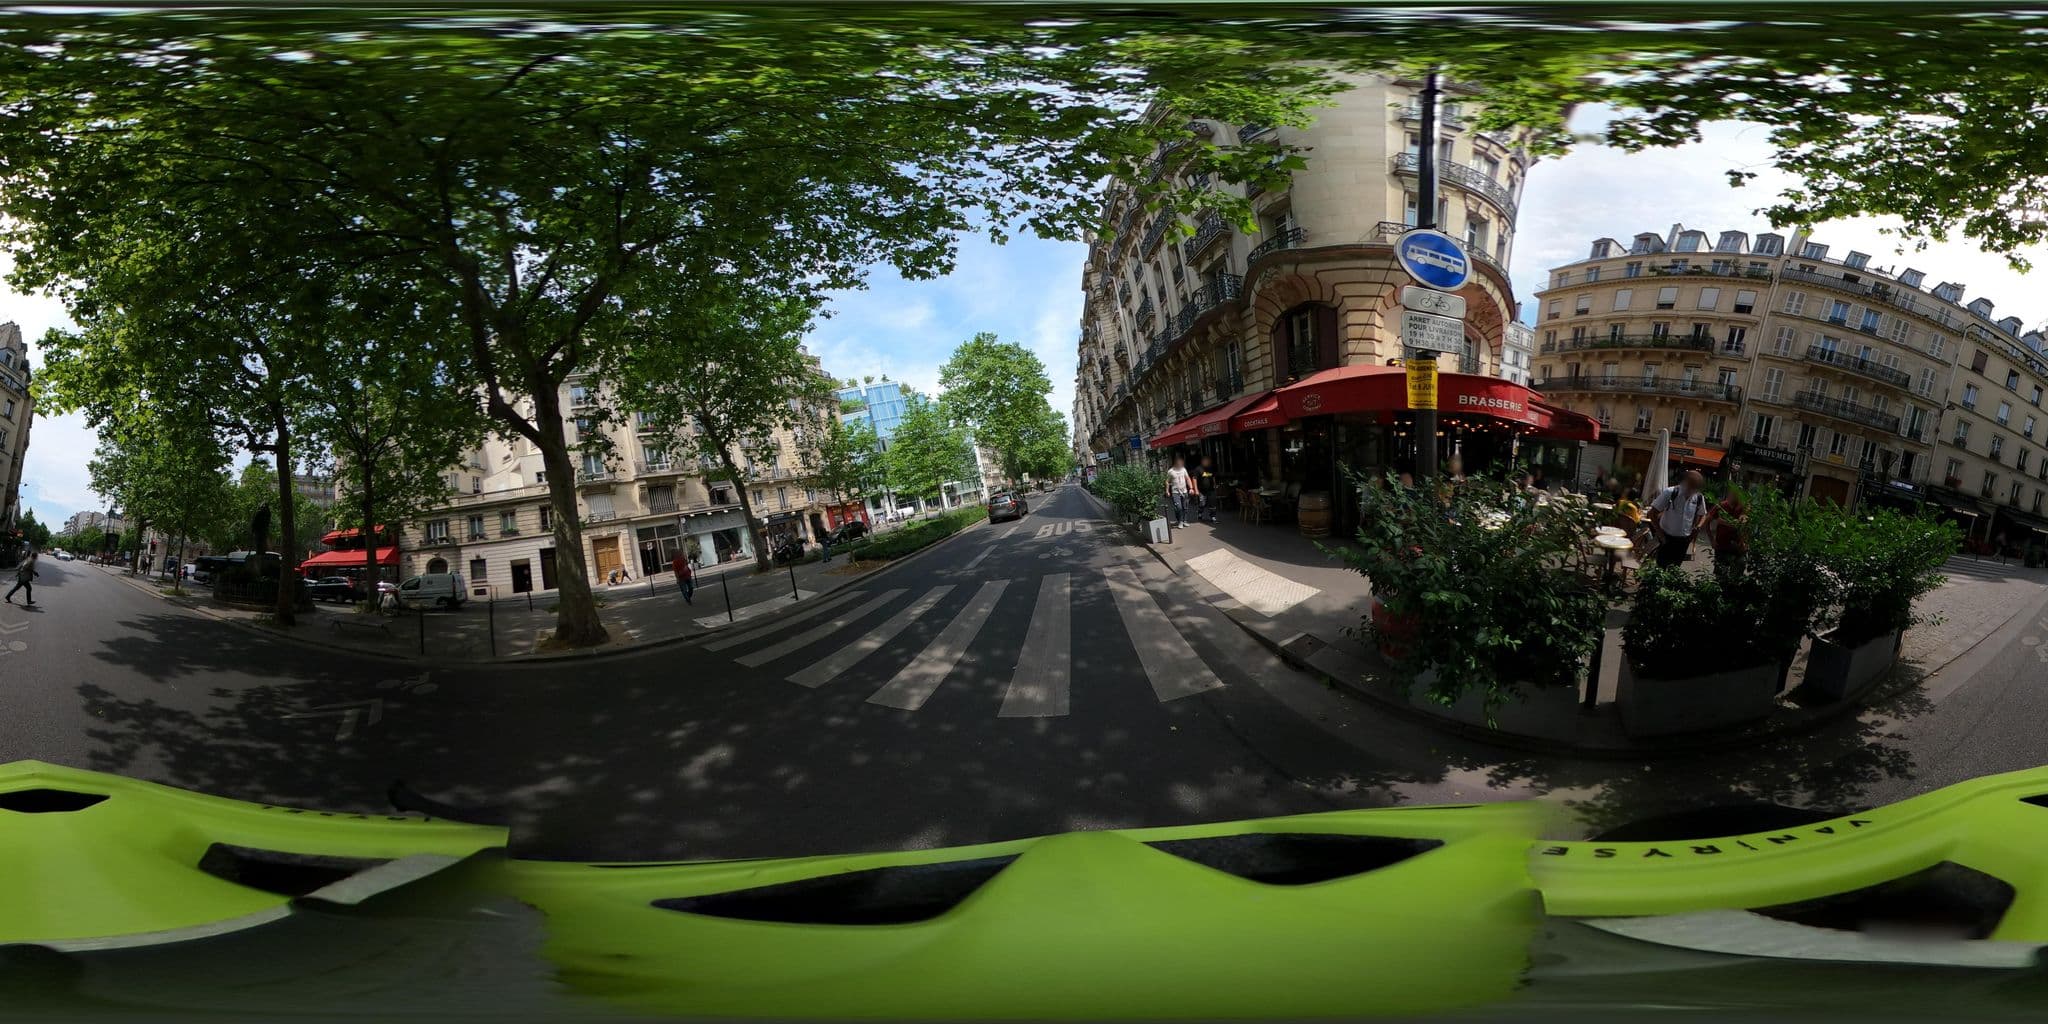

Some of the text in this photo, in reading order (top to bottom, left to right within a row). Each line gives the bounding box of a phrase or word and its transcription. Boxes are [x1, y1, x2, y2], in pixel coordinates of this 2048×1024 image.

[1409, 315, 1430, 324] ARRET
[1409, 323, 1427, 332] POUR
[1458, 394, 1523, 413] BRASSERIE
[1244, 417, 1268, 428] COCKTAILS
[1033, 519, 1092, 539] BUS
